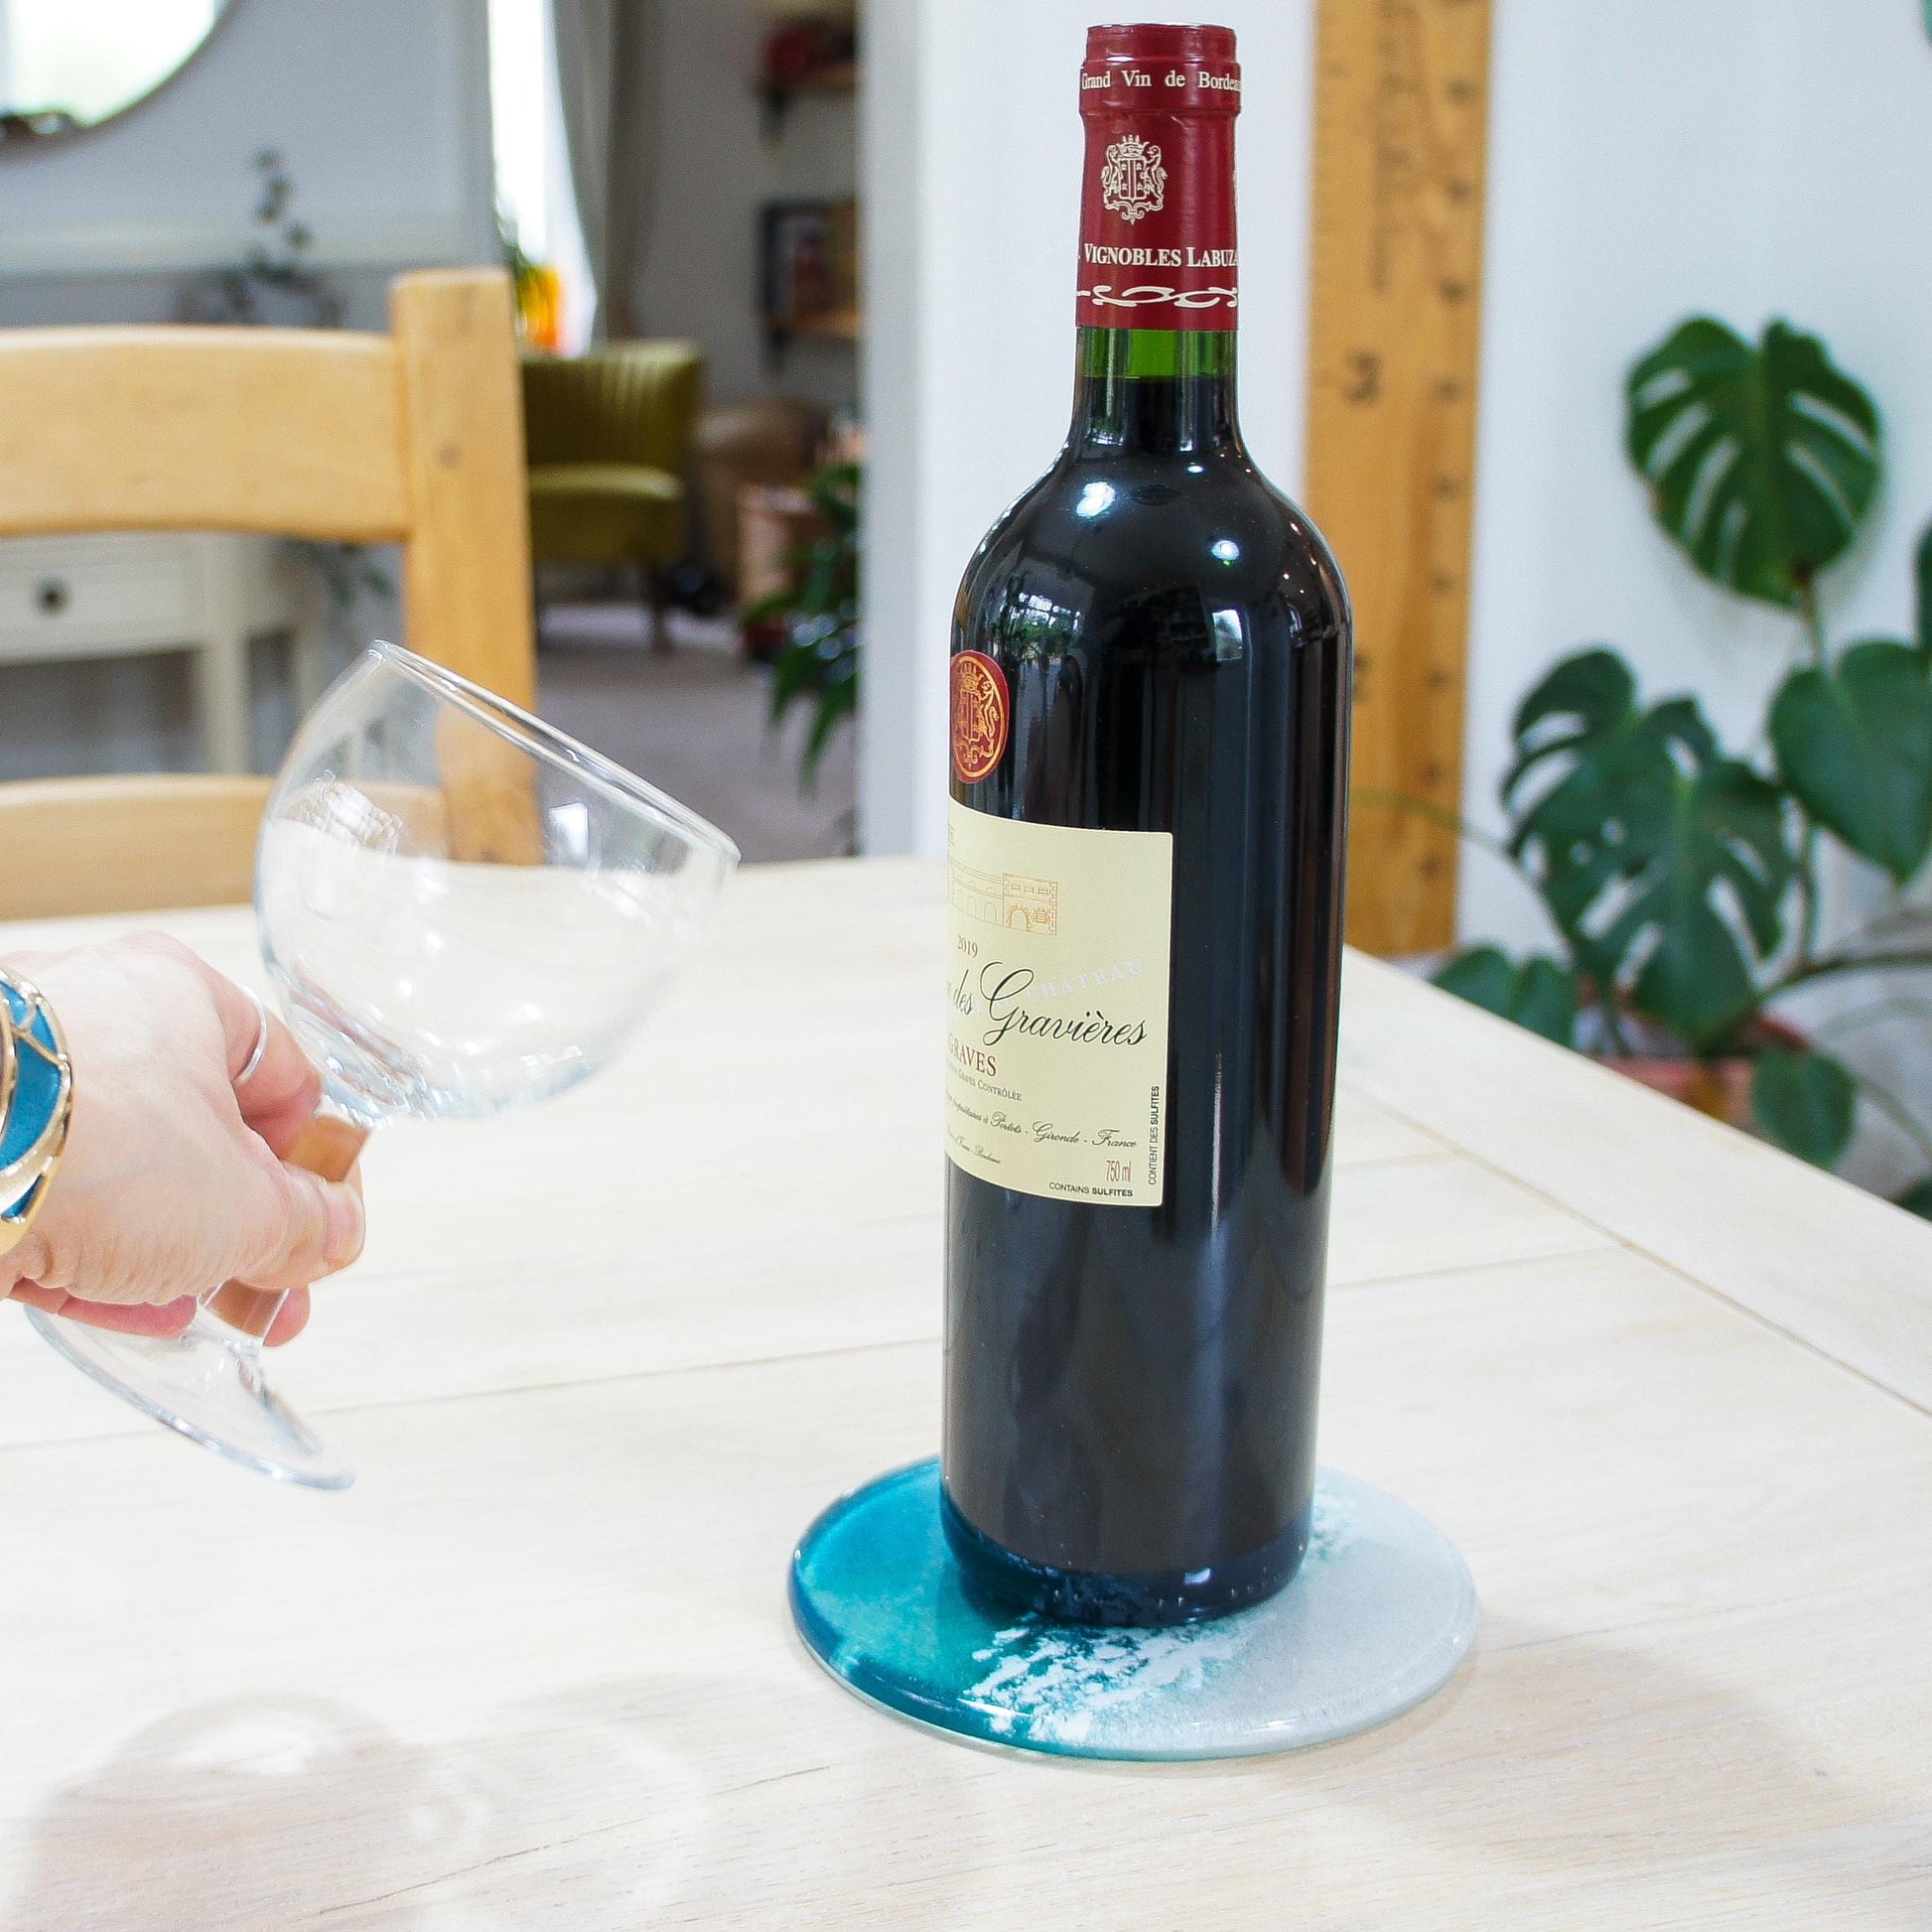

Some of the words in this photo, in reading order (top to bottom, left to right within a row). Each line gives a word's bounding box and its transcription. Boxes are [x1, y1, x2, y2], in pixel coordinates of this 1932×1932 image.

[1082, 70, 1111, 89] Grand
[1122, 69, 1152, 87] Vin
[1165, 70, 1186, 87] de
[1084, 243, 1182, 267] VIGNOBLES
[957, 934, 978, 958] 2019
[953, 968, 974, 1016] des
[980, 961, 1147, 1045] Gravières
[1151, 1085, 1160, 1125] SULFITES
[1033, 1121, 1080, 1143] Gironde
[1092, 1128, 1137, 1148] France
[1150, 1127, 1159, 1143] DES
[1106, 1160, 1121, 1181] 750
[1122, 1161, 1132, 1182] ml
[1148, 1146, 1158, 1185] CONTIENT
[1048, 1181, 1090, 1194] CONTAINS
[1091, 1188, 1133, 1197] SULFITES
